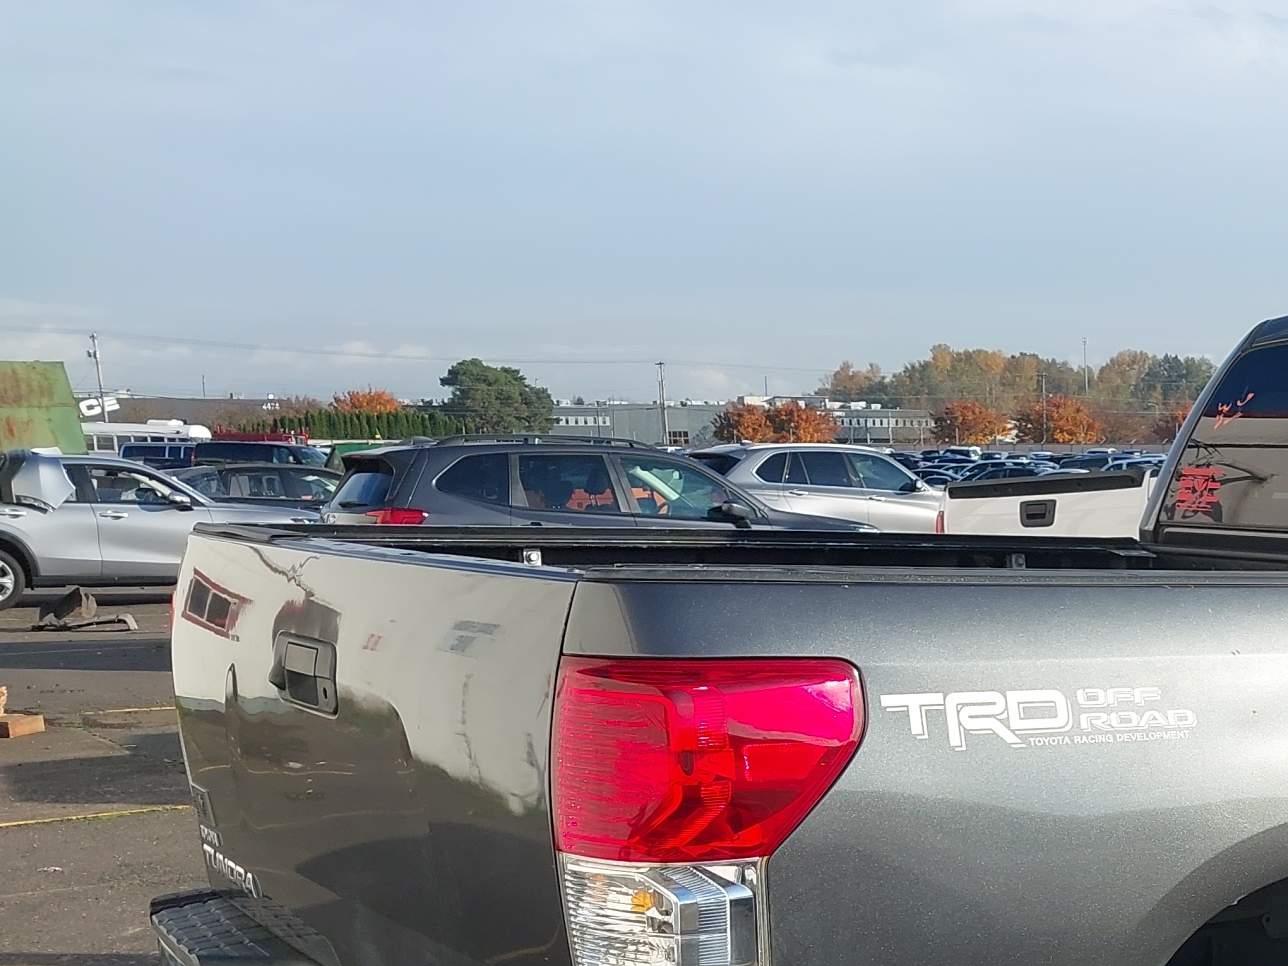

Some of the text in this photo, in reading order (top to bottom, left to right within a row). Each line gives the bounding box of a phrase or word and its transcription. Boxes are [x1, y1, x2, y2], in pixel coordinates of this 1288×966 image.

[1076, 687, 1162, 707] OFF
[880, 689, 1073, 751] TRD
[1079, 709, 1198, 732] ROAD
[1029, 735, 1071, 747] TOYOTA
[1073, 733, 1114, 745] RACING
